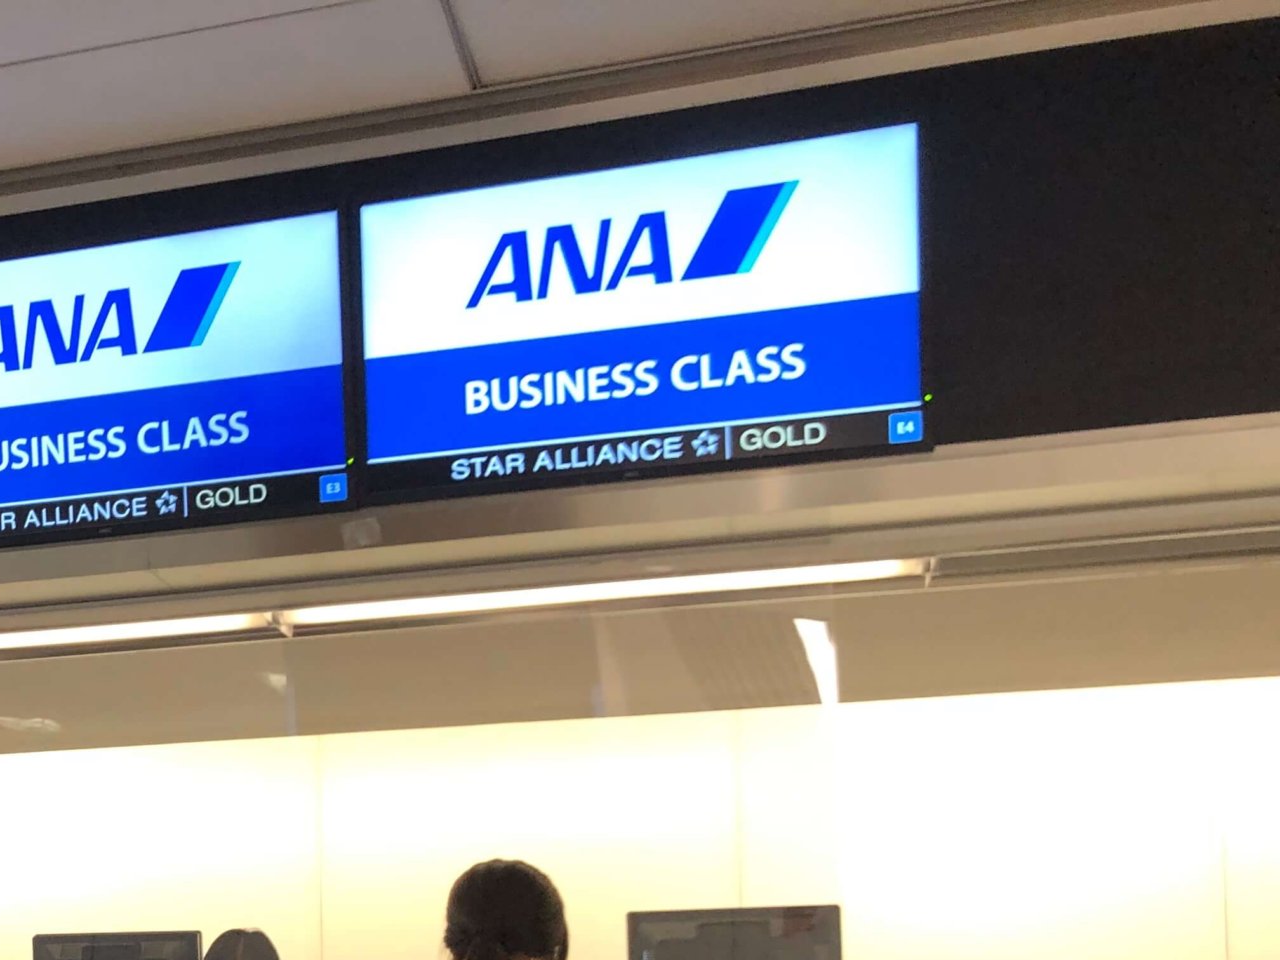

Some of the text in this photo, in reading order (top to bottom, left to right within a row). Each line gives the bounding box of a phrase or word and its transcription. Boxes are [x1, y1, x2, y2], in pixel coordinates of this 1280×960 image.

[465, 211, 674, 309] ANA
[464, 342, 807, 415] BUSINESS CLASS
[136, 410, 250, 454] CLASS
[451, 421, 827, 481] STAR ALLIANCE GOLD
[896, 420, 915, 435] E4
[23, 495, 148, 530] ALLIANCE
[195, 482, 268, 511] GOLD
